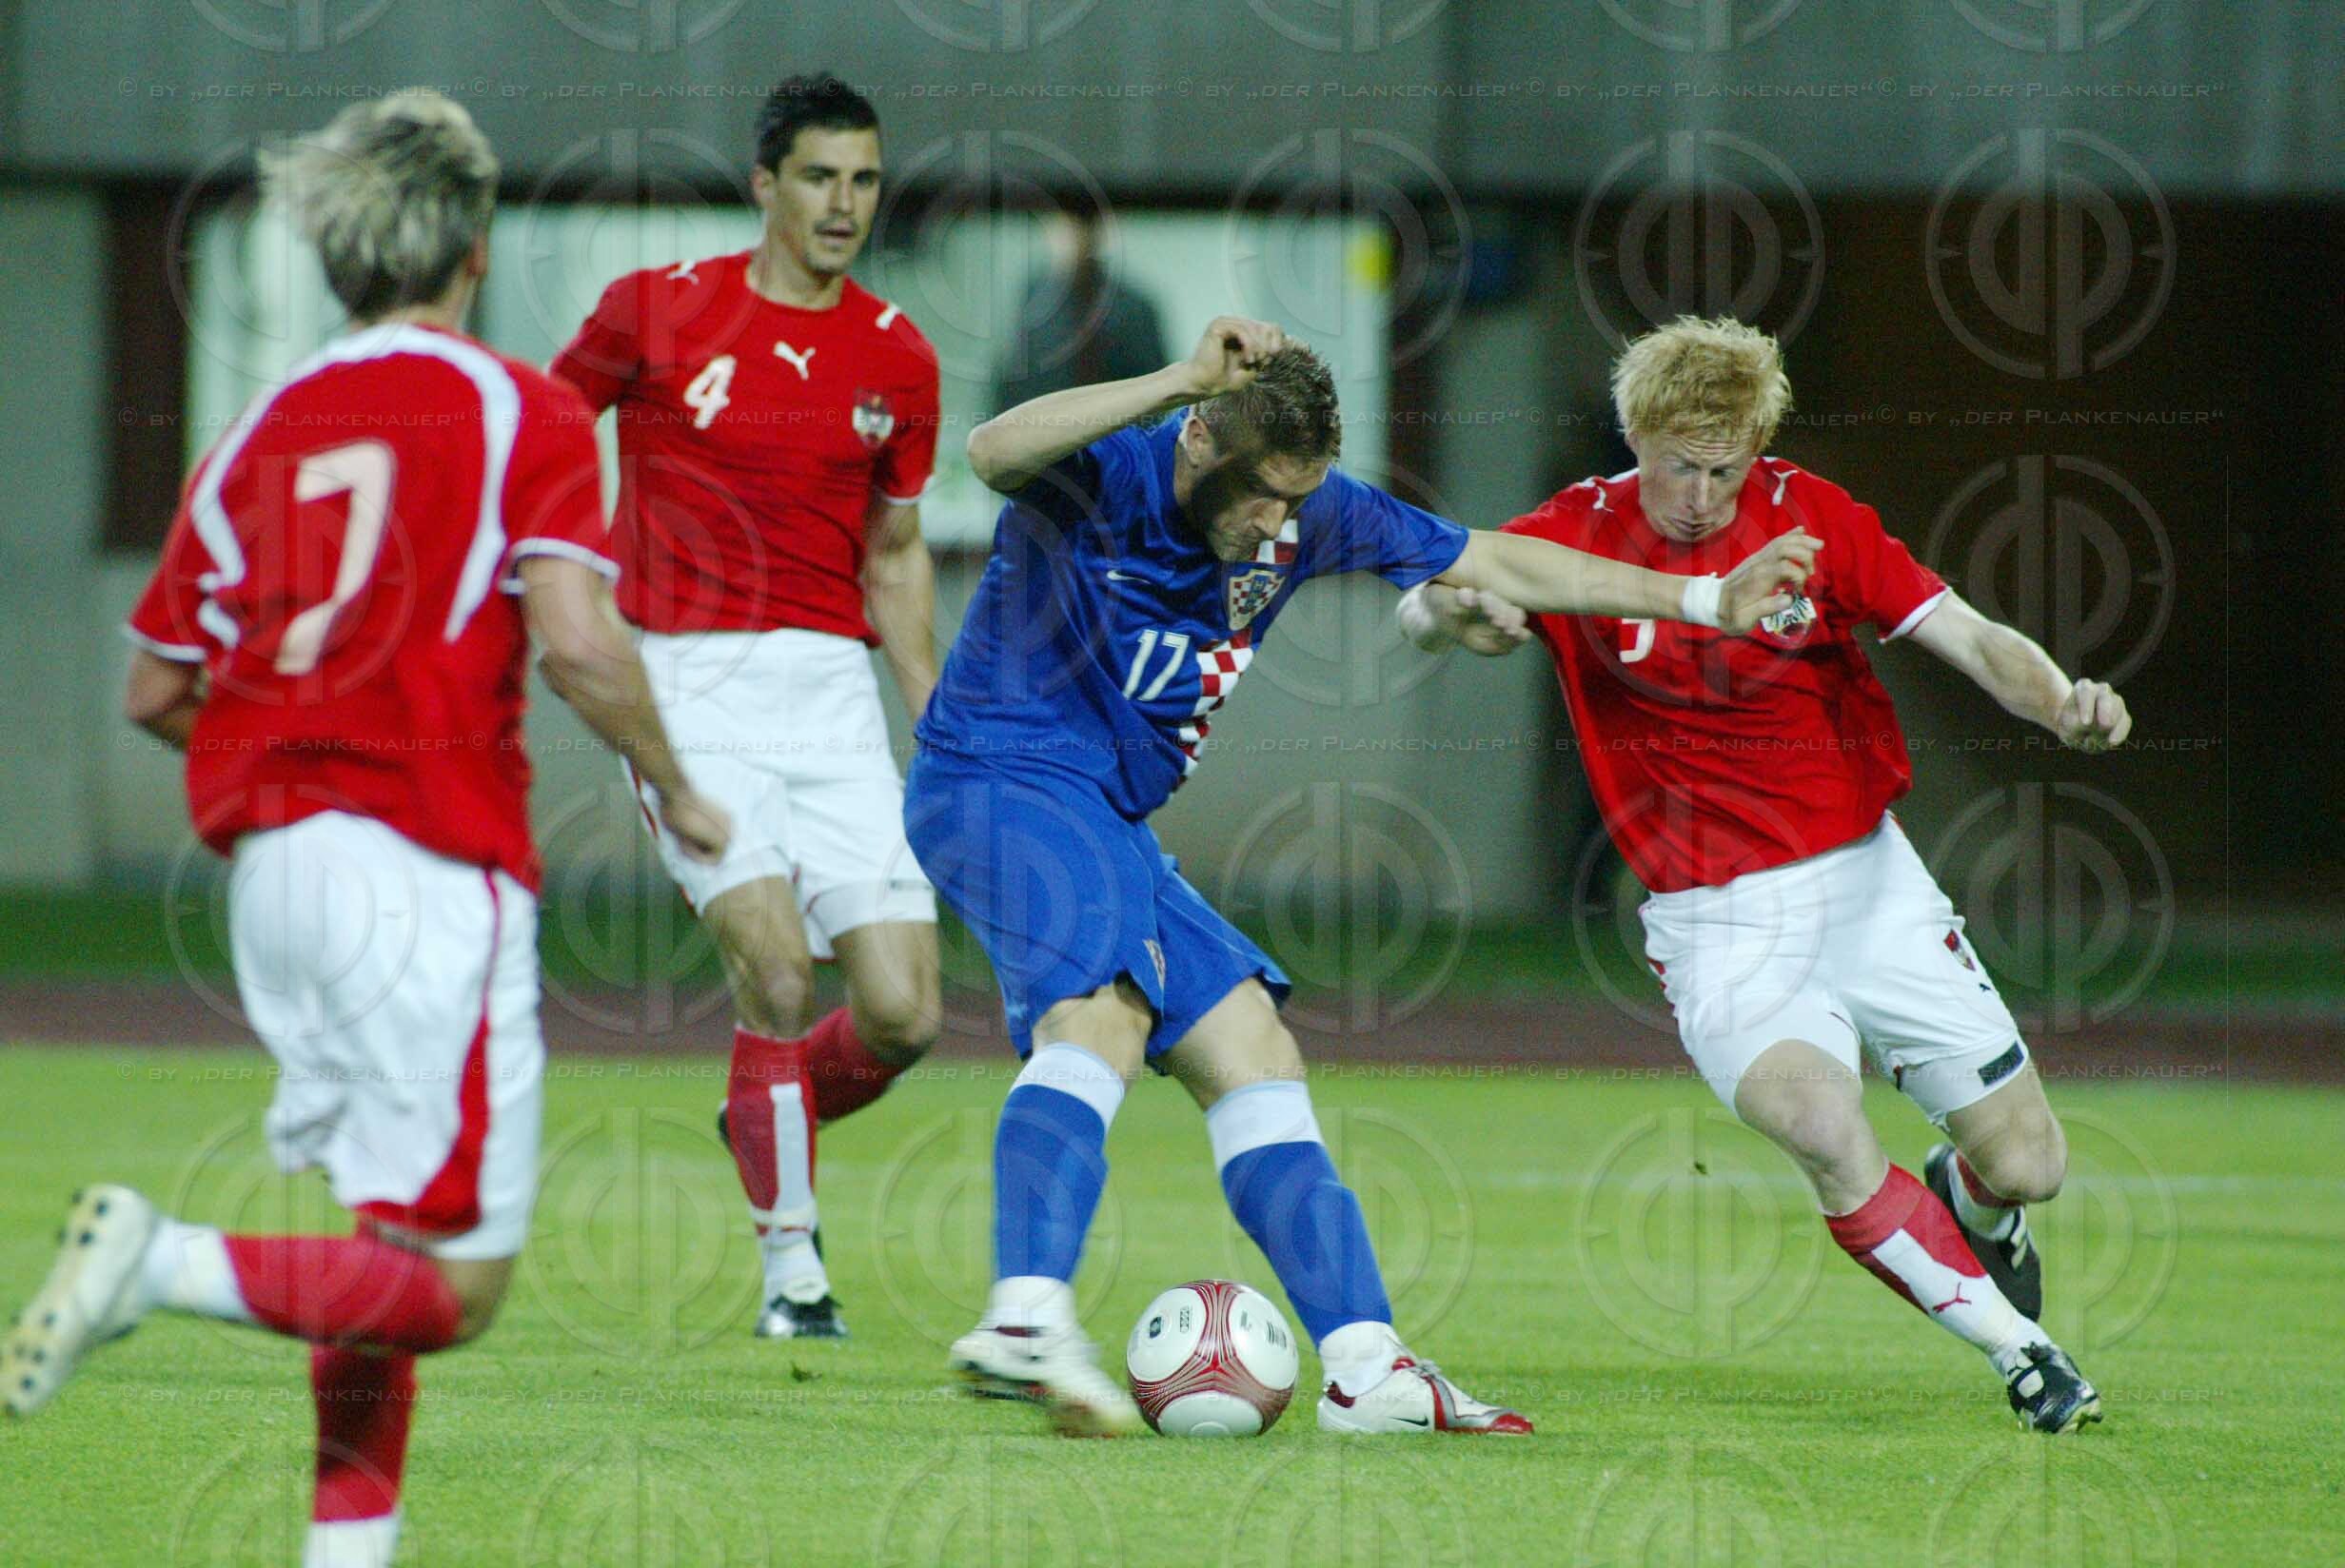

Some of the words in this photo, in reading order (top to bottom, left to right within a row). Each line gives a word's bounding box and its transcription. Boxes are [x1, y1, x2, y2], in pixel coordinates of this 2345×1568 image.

[684, 356, 736, 430] 4
[275, 441, 395, 676] 7
[1122, 629, 1191, 702] 17
